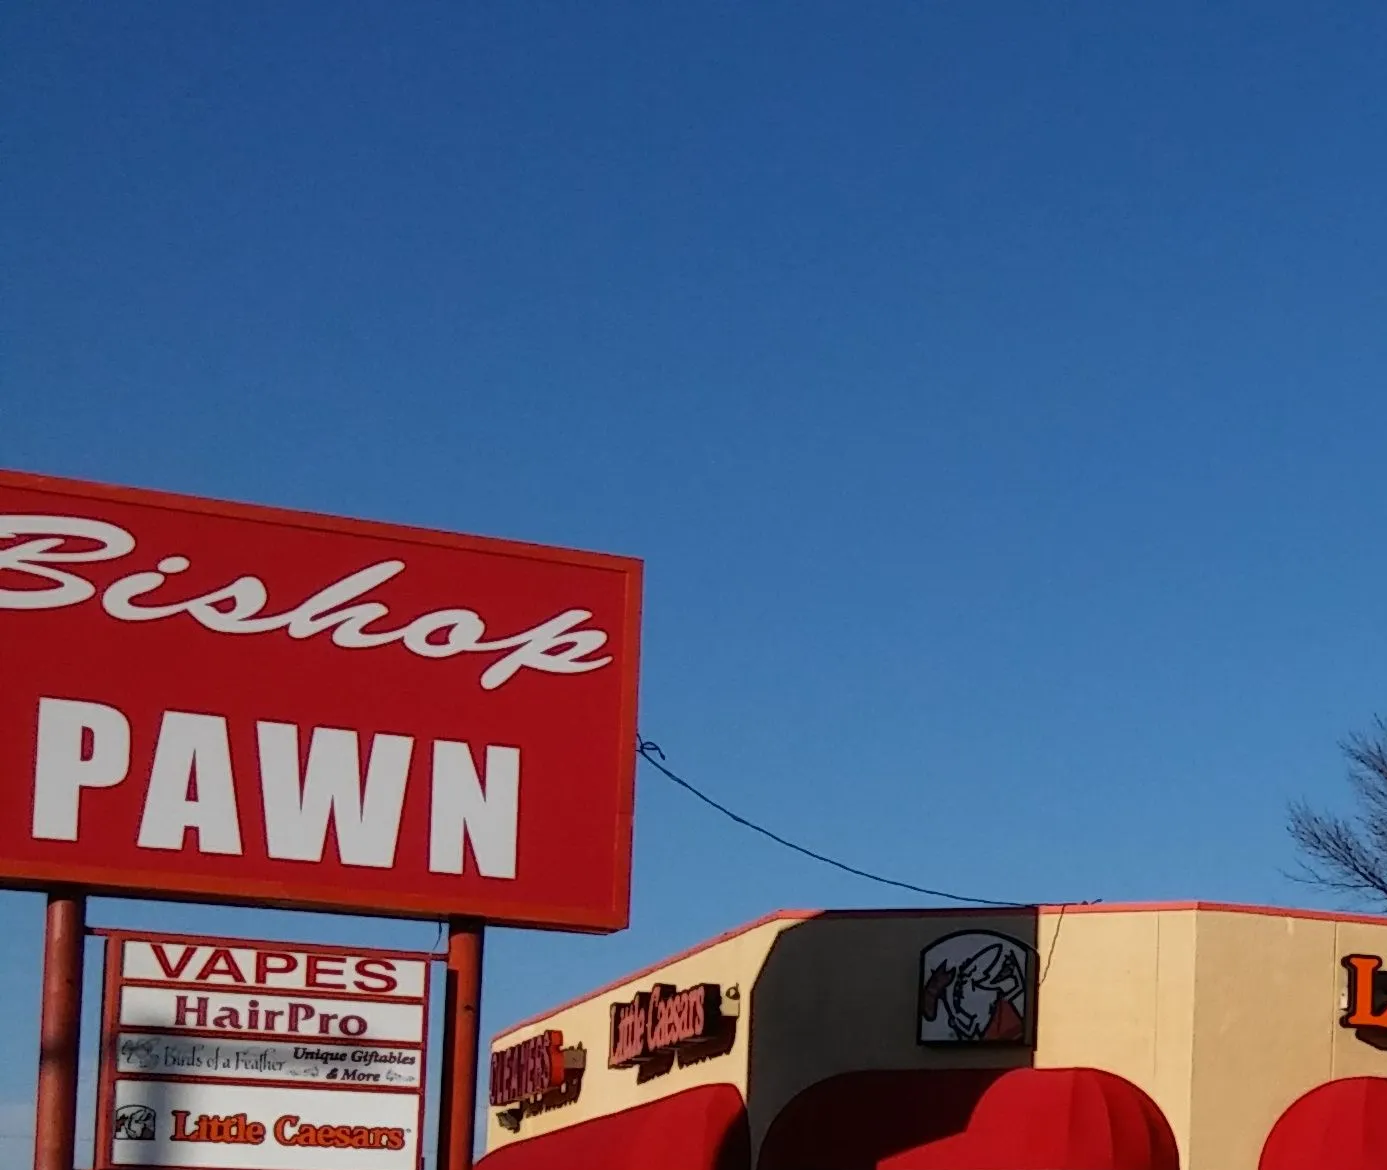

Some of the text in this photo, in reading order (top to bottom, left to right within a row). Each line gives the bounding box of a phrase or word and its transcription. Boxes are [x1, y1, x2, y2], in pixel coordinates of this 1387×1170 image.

[0, 514, 612, 689] Bishop
[32, 696, 520, 879] PAWN
[151, 944, 398, 993] VAPES
[174, 995, 368, 1036] HairPro
[609, 986, 706, 1068] Little Caesars
[164, 1045, 202, 1067] Birds
[222, 1057, 231, 1069] a
[235, 1047, 286, 1073] Feather
[293, 1047, 416, 1066] Unique Giftables
[340, 1070, 381, 1082] More
[170, 1110, 405, 1150] Little Caesars
